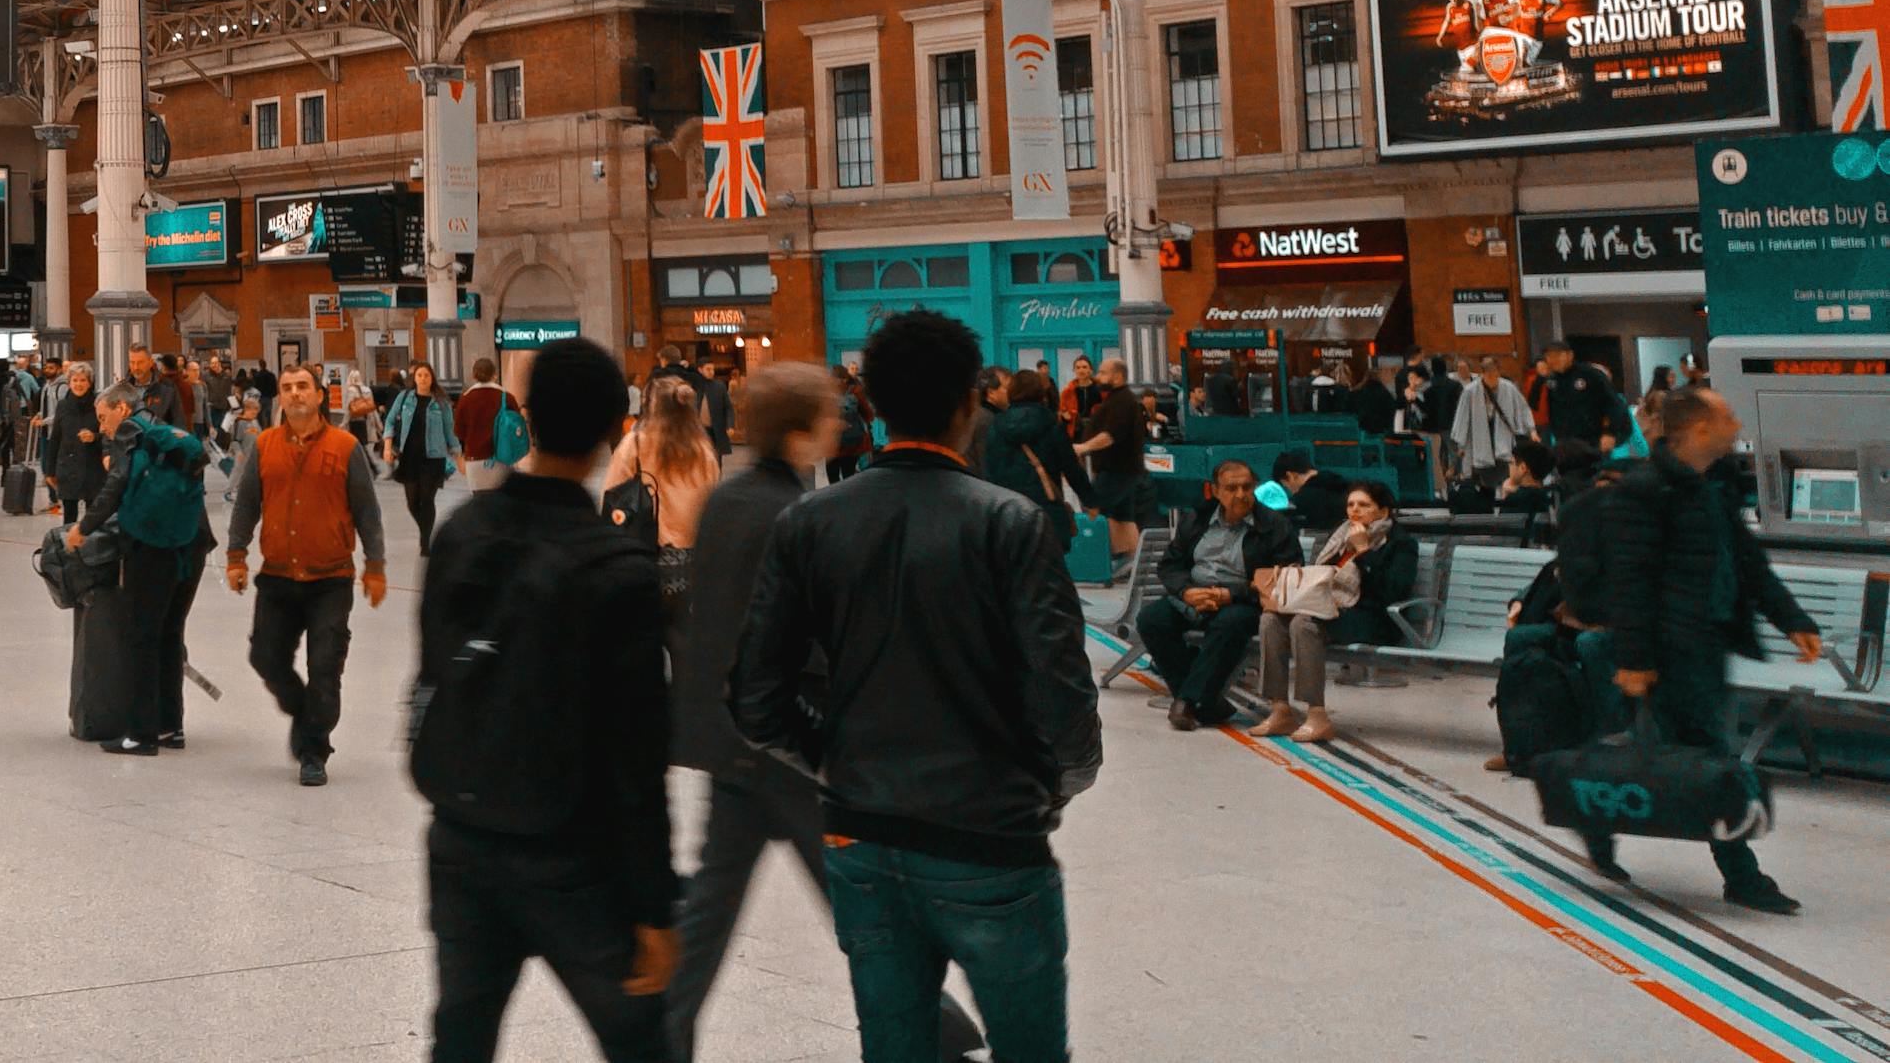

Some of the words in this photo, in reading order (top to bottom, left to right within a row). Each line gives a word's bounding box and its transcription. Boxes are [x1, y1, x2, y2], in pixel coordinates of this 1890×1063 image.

[1565, 8, 1672, 47] STADIUM
[1483, 41, 1515, 53] Arsenal
[1569, 45, 1587, 59] GET
[1588, 41, 1622, 57] CLOSER
[1624, 41, 1636, 54] TO
[1638, 39, 1655, 53] THE
[1656, 36, 1683, 51] HOME
[1684, 35, 1698, 49] OF
[1699, 31, 1747, 47] FOOTBALL
[1611, 79, 1709, 99] arsenal.com/tours
[267, 212, 288, 234] ALEX
[287, 201, 313, 224] CROSS
[1718, 207, 1762, 230] Train
[1766, 204, 1830, 228] tickets
[1834, 203, 1868, 229] buy
[1875, 201, 1890, 224] &
[157, 232, 171, 246] the
[171, 229, 205, 246] Michelin
[205, 229, 222, 243] diet
[1259, 227, 1360, 257] NatWest
[1539, 277, 1570, 290] FREE
[1794, 288, 1816, 301] Cash
[1826, 288, 1847, 300] card
[1018, 297, 1103, 331] Paperchase
[1206, 307, 1238, 321] Free
[1241, 306, 1279, 321] cash
[1282, 303, 1384, 320] withdrawals
[1467, 313, 1498, 326] FREE
[1202, 348, 1231, 359] NatWest
[1254, 348, 1279, 359] NatWe
[1321, 348, 1354, 359] NatWest
